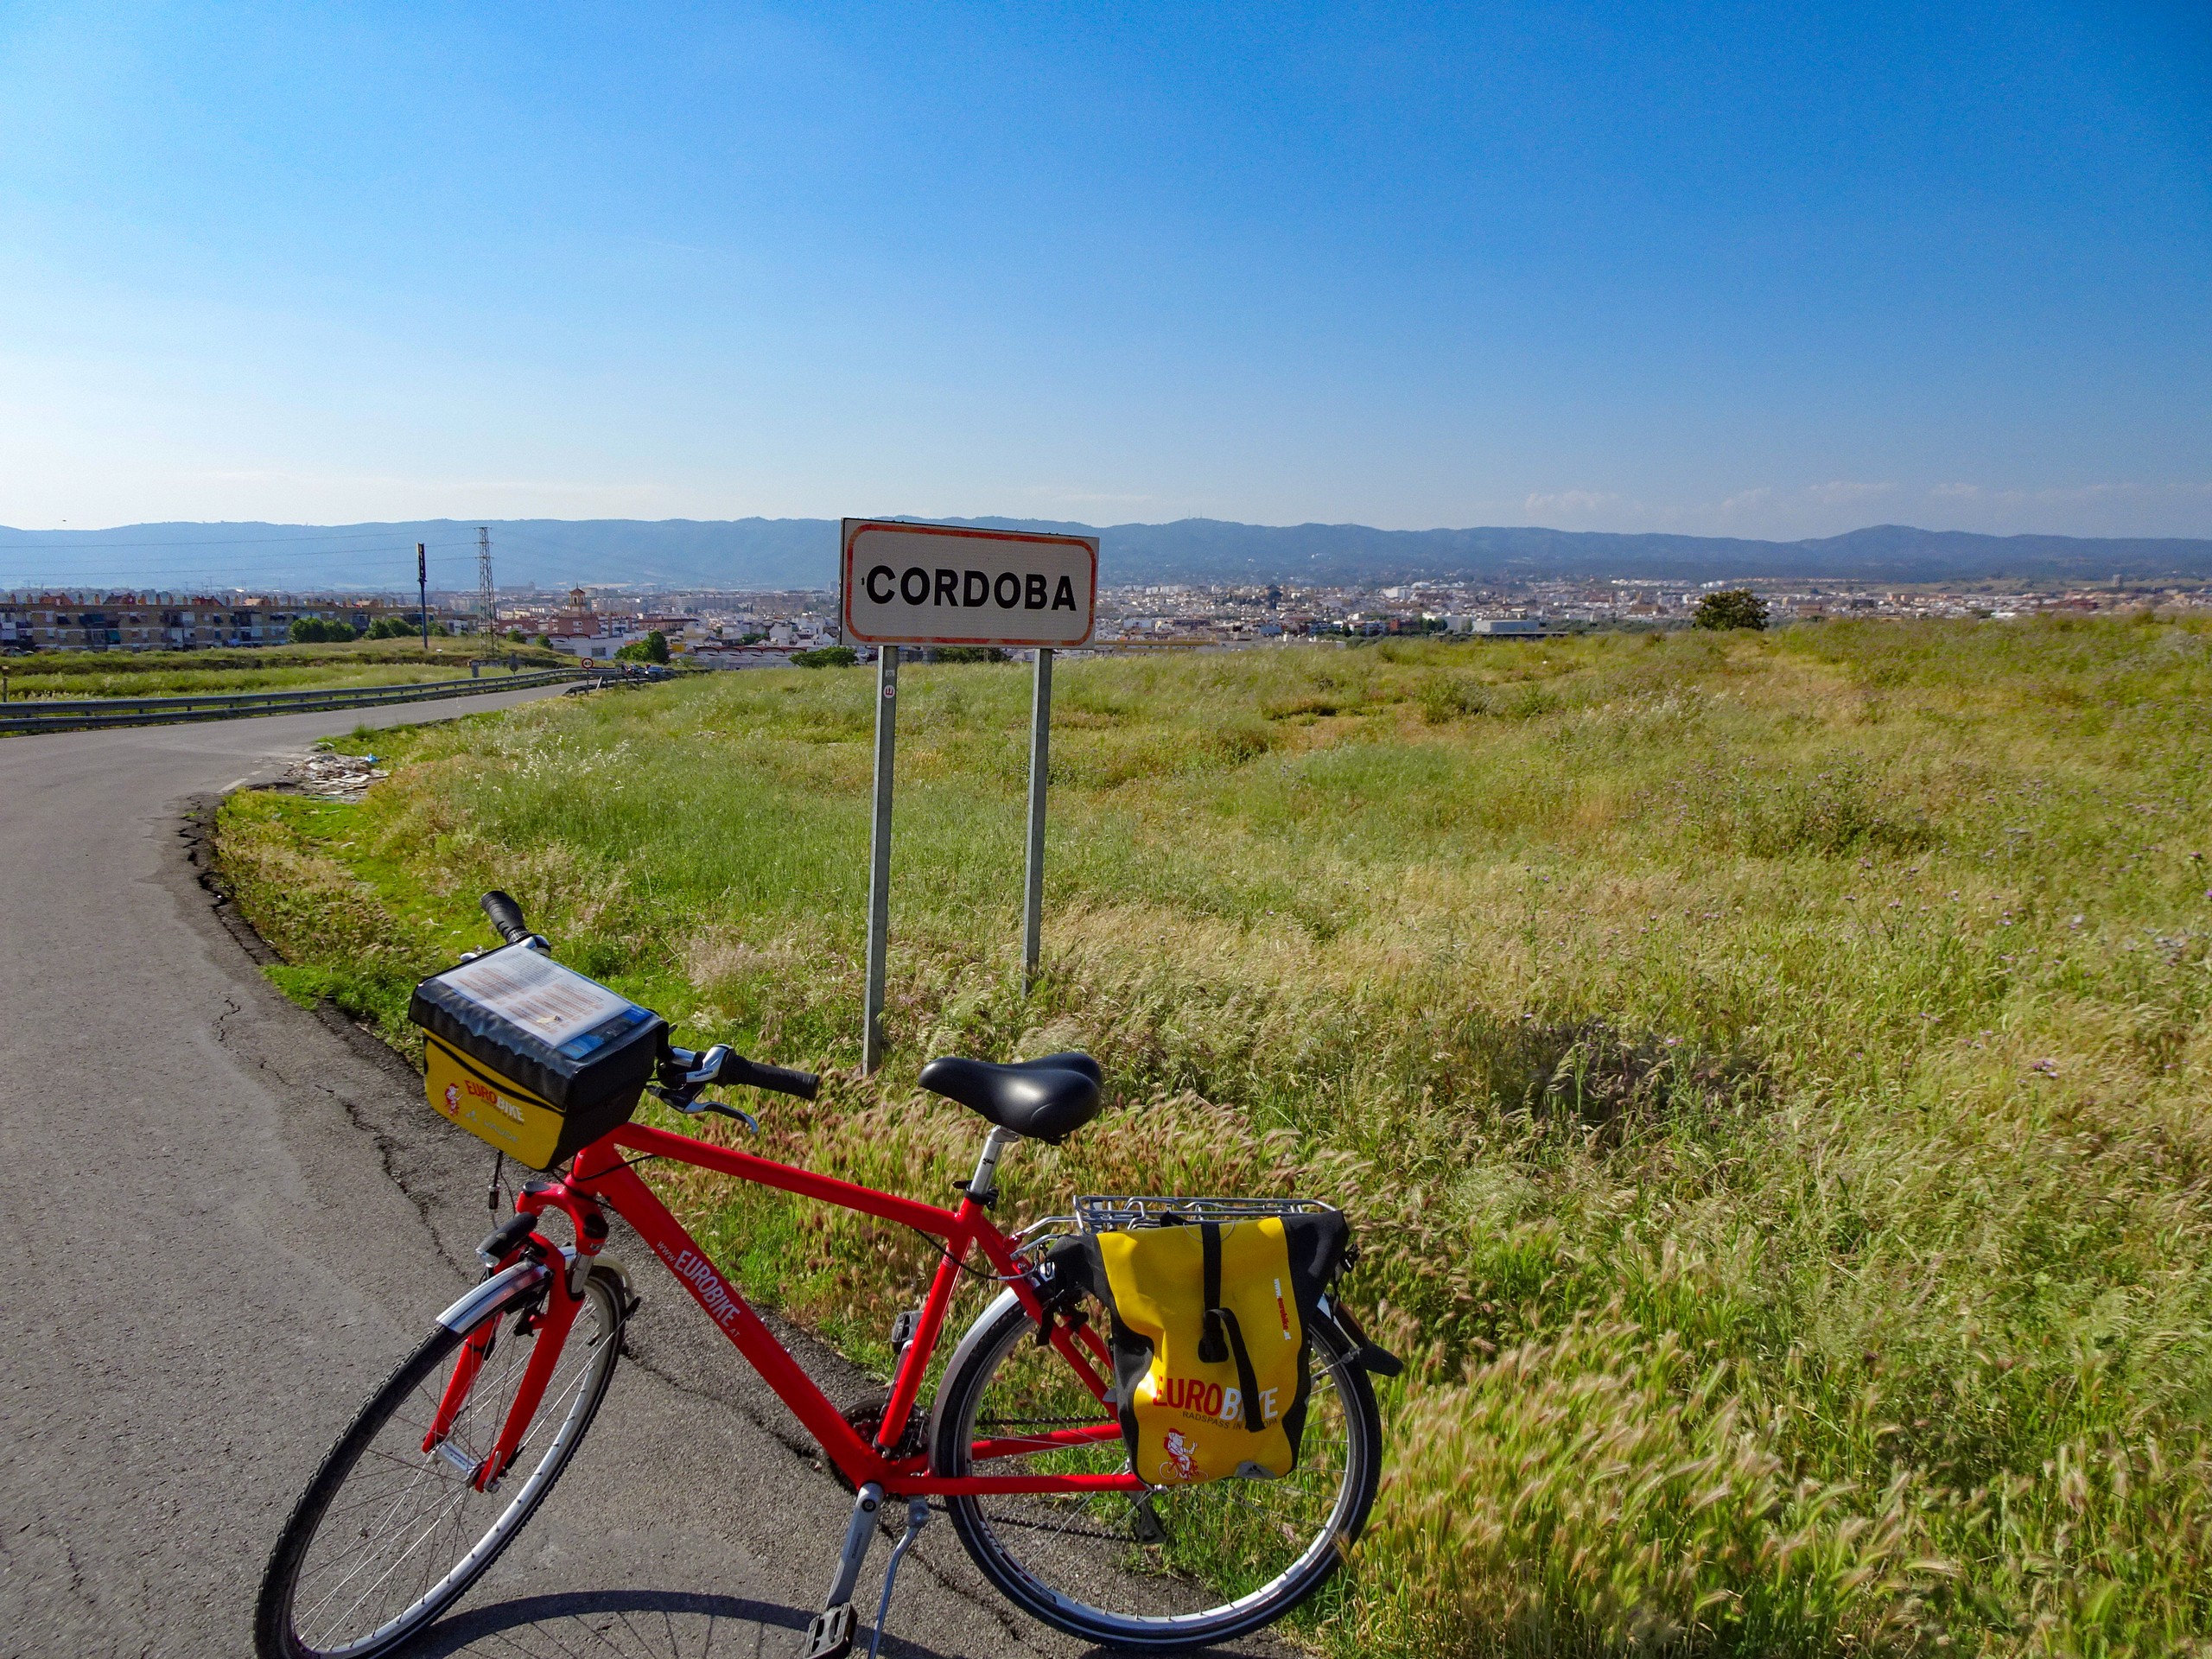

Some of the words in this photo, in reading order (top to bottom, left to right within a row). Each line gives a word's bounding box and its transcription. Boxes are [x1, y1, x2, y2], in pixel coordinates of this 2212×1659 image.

[866, 564, 1077, 612] CORDOBA
[464, 1079, 524, 1122] EUROBIKE
[1153, 1376, 1278, 1422] EUROBE
[1182, 1410, 1230, 1429] RADSPASS
[1232, 1421, 1243, 1430] IN
